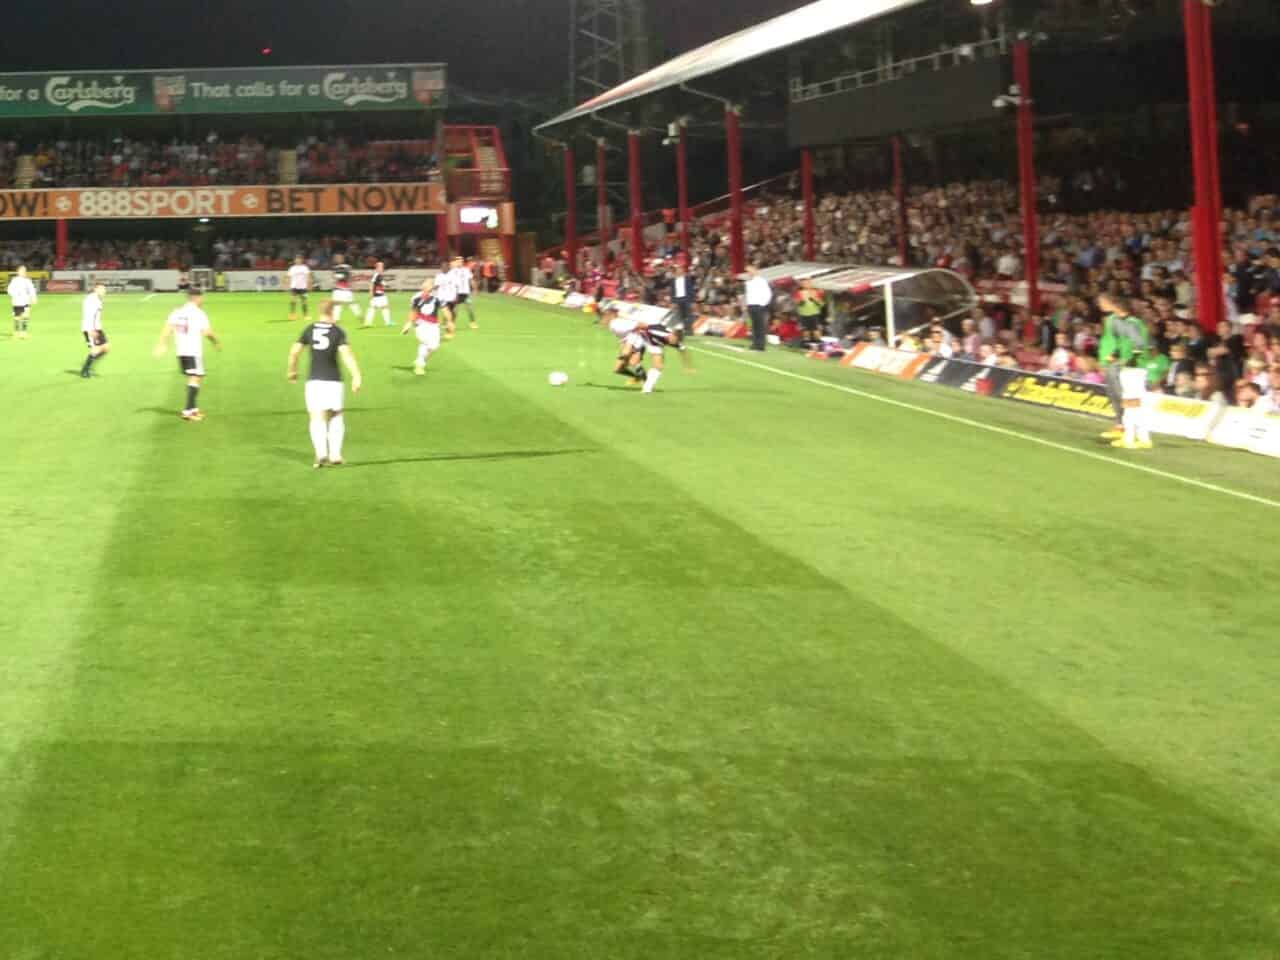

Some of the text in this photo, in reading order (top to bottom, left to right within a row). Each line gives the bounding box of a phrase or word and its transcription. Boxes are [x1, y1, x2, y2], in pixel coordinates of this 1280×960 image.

[27, 89, 39, 101] a
[45, 76, 135, 111] Carlsberg
[190, 72, 408, 106] That calls for a Carlsberg
[79, 189, 236, 216] 888SPORT
[267, 188, 327, 213] BET
[338, 186, 430, 212] NOW!
[312, 327, 330, 350] 5
